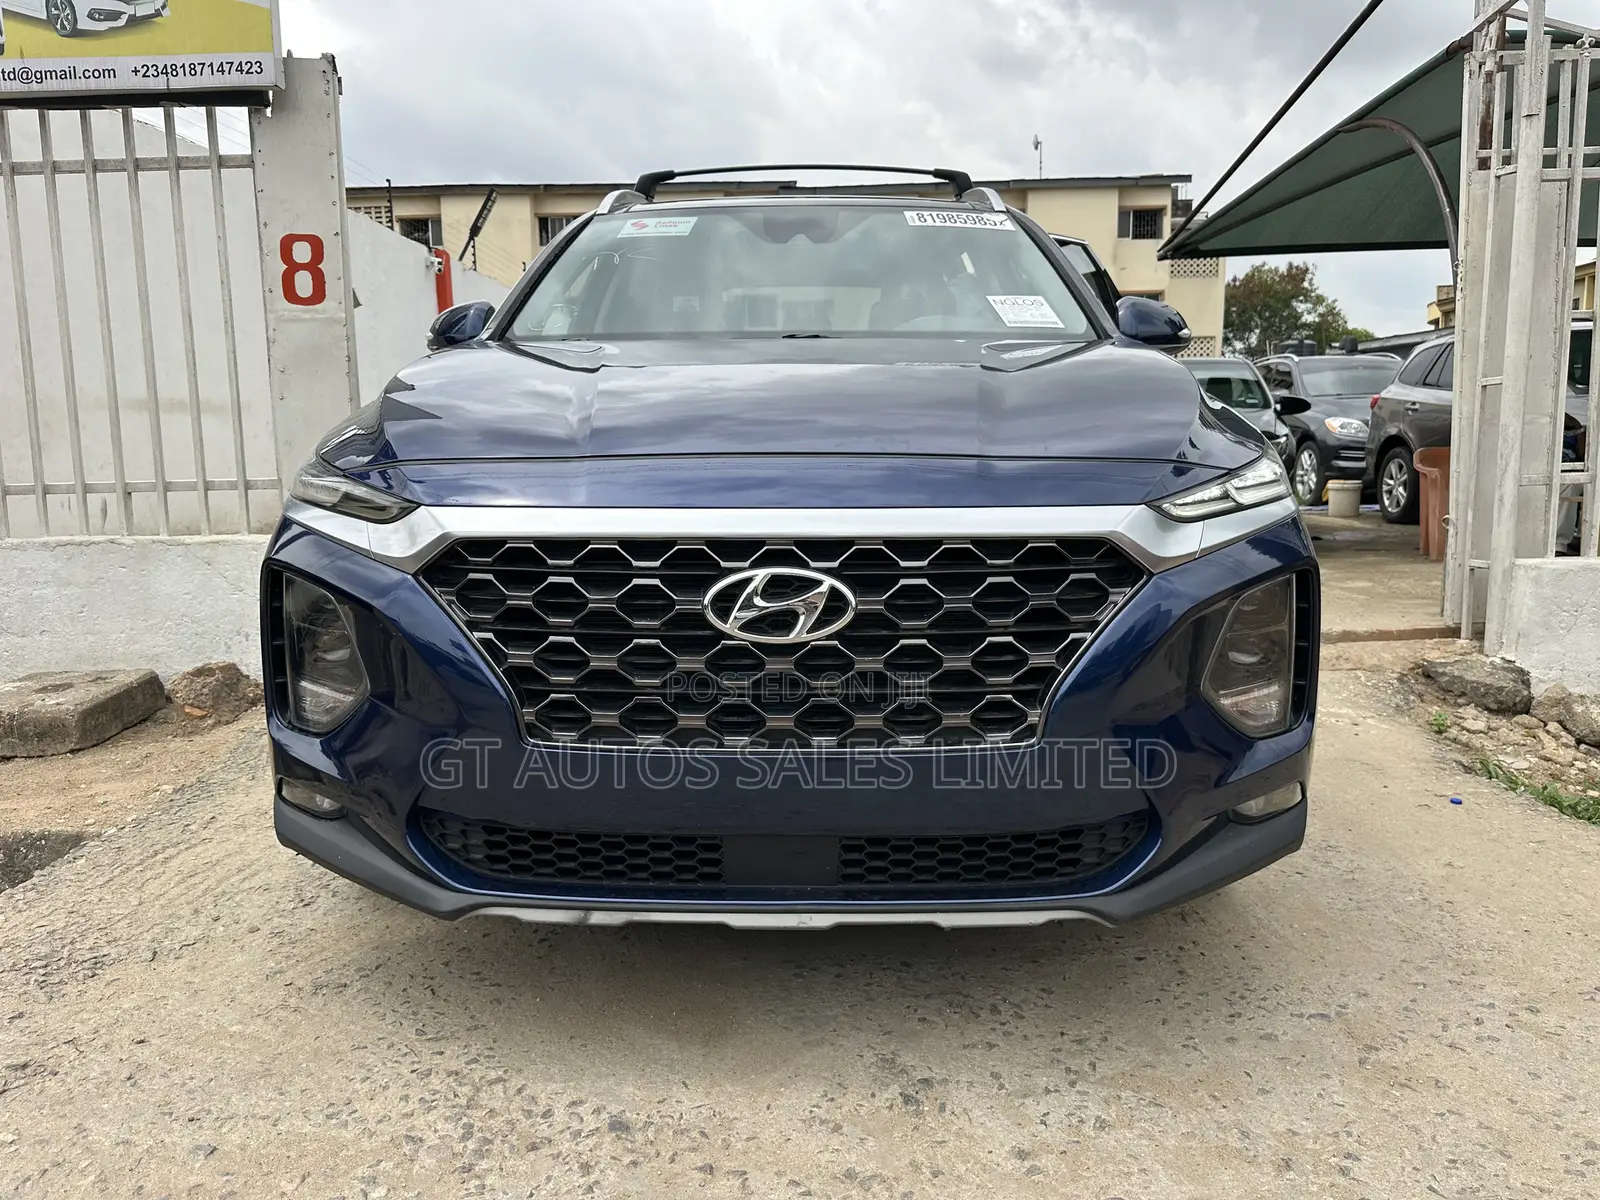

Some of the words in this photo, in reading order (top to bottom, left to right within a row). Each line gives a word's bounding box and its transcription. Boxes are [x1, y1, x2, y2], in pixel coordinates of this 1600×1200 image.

[0, 66, 117, 84] td@gmail.com
[131, 60, 264, 78] +2348187147423
[279, 232, 327, 306] 8
[992, 298, 1045, 307] NGLOS
